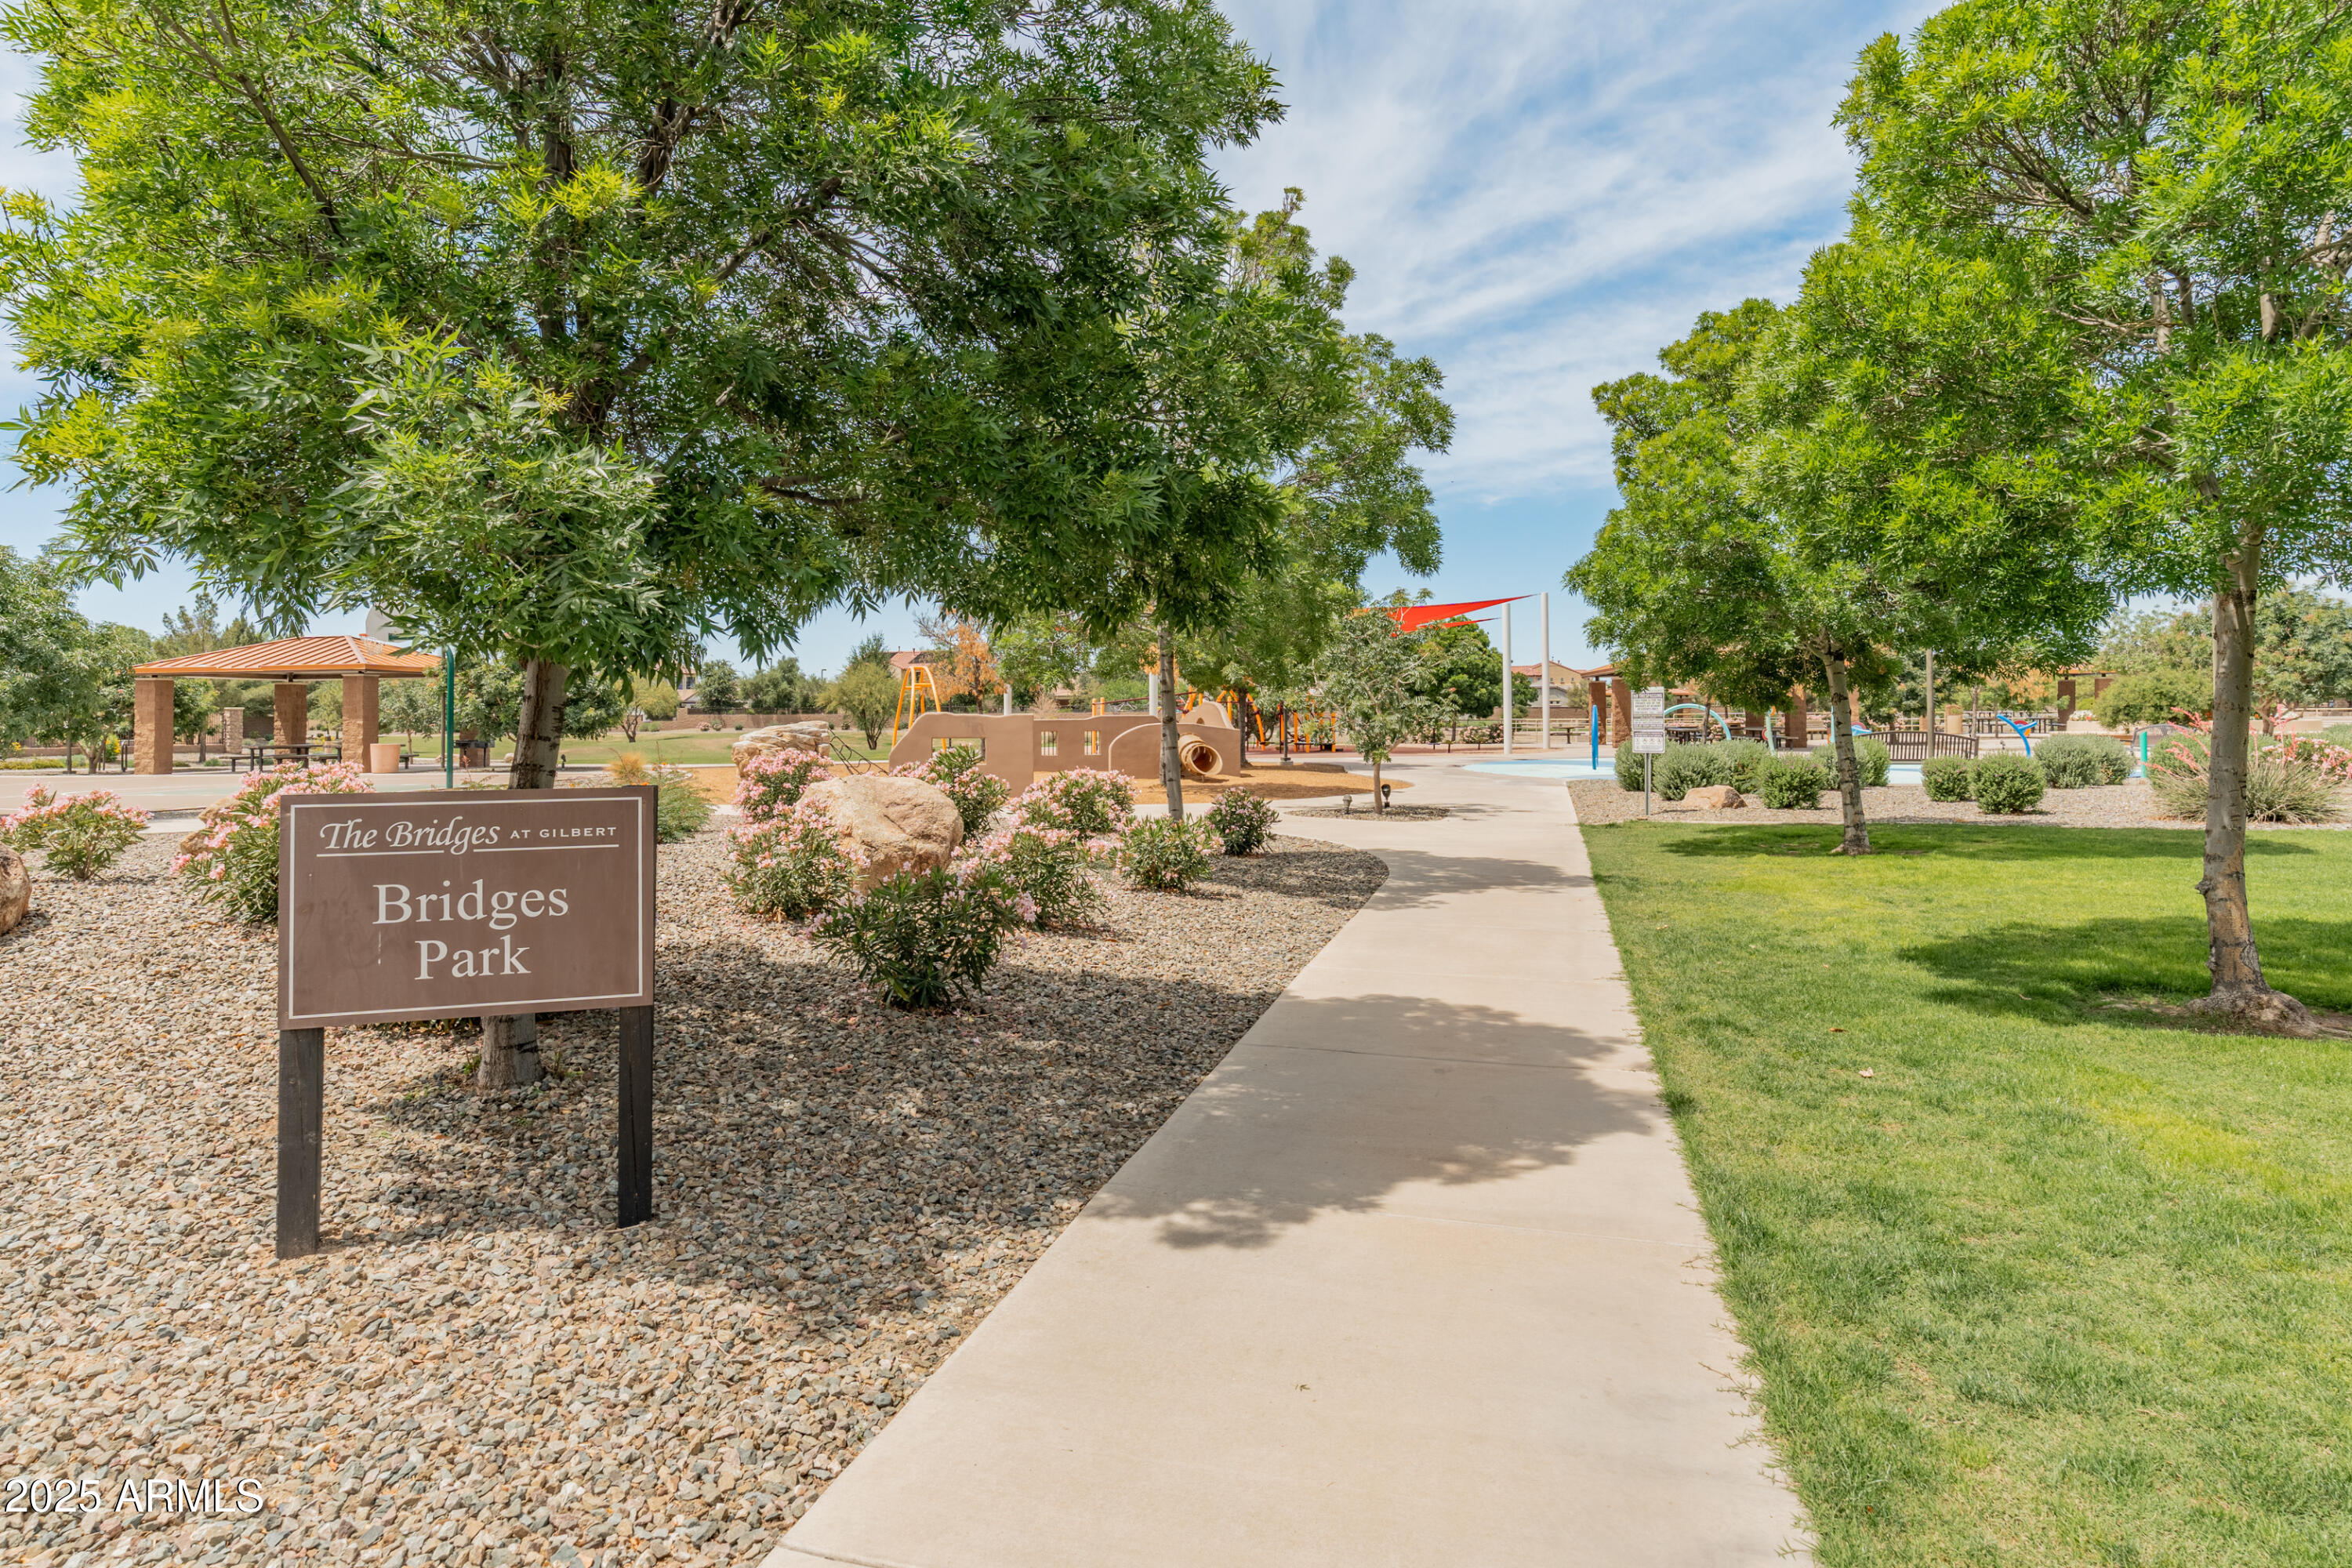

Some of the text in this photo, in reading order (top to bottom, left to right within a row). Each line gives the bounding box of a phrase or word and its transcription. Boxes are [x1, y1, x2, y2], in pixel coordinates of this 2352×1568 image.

[319, 815, 617, 855] The Bridges AT GILBERT
[372, 878, 568, 931] Bridges
[415, 934, 532, 980] Park
